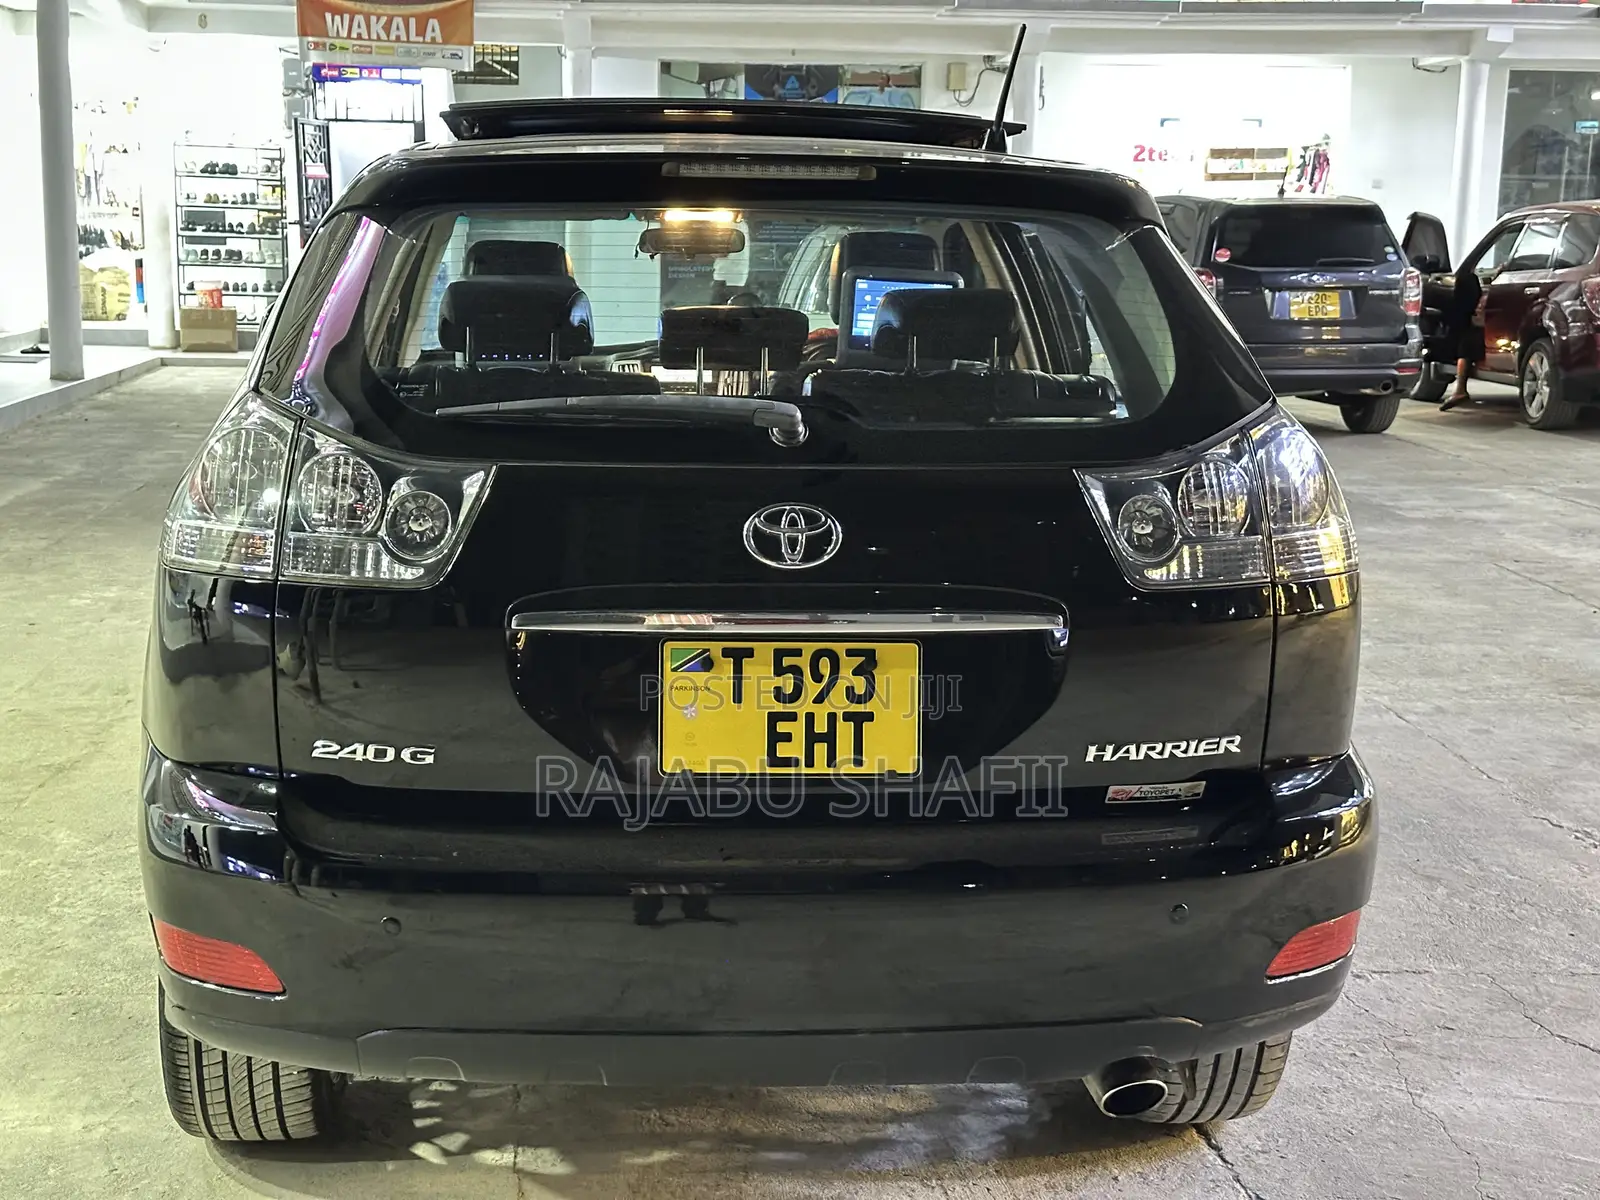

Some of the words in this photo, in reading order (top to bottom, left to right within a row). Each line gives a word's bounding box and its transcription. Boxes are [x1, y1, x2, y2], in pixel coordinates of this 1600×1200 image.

[325, 12, 443, 43] WAKALA
[721, 647, 755, 704] T
[772, 648, 877, 705] 593
[311, 739, 396, 763] 240
[400, 746, 436, 765] G
[766, 711, 875, 768] EHT
[1085, 734, 1242, 763] HARRIER
[1139, 788, 1176, 796] TOYOPET
